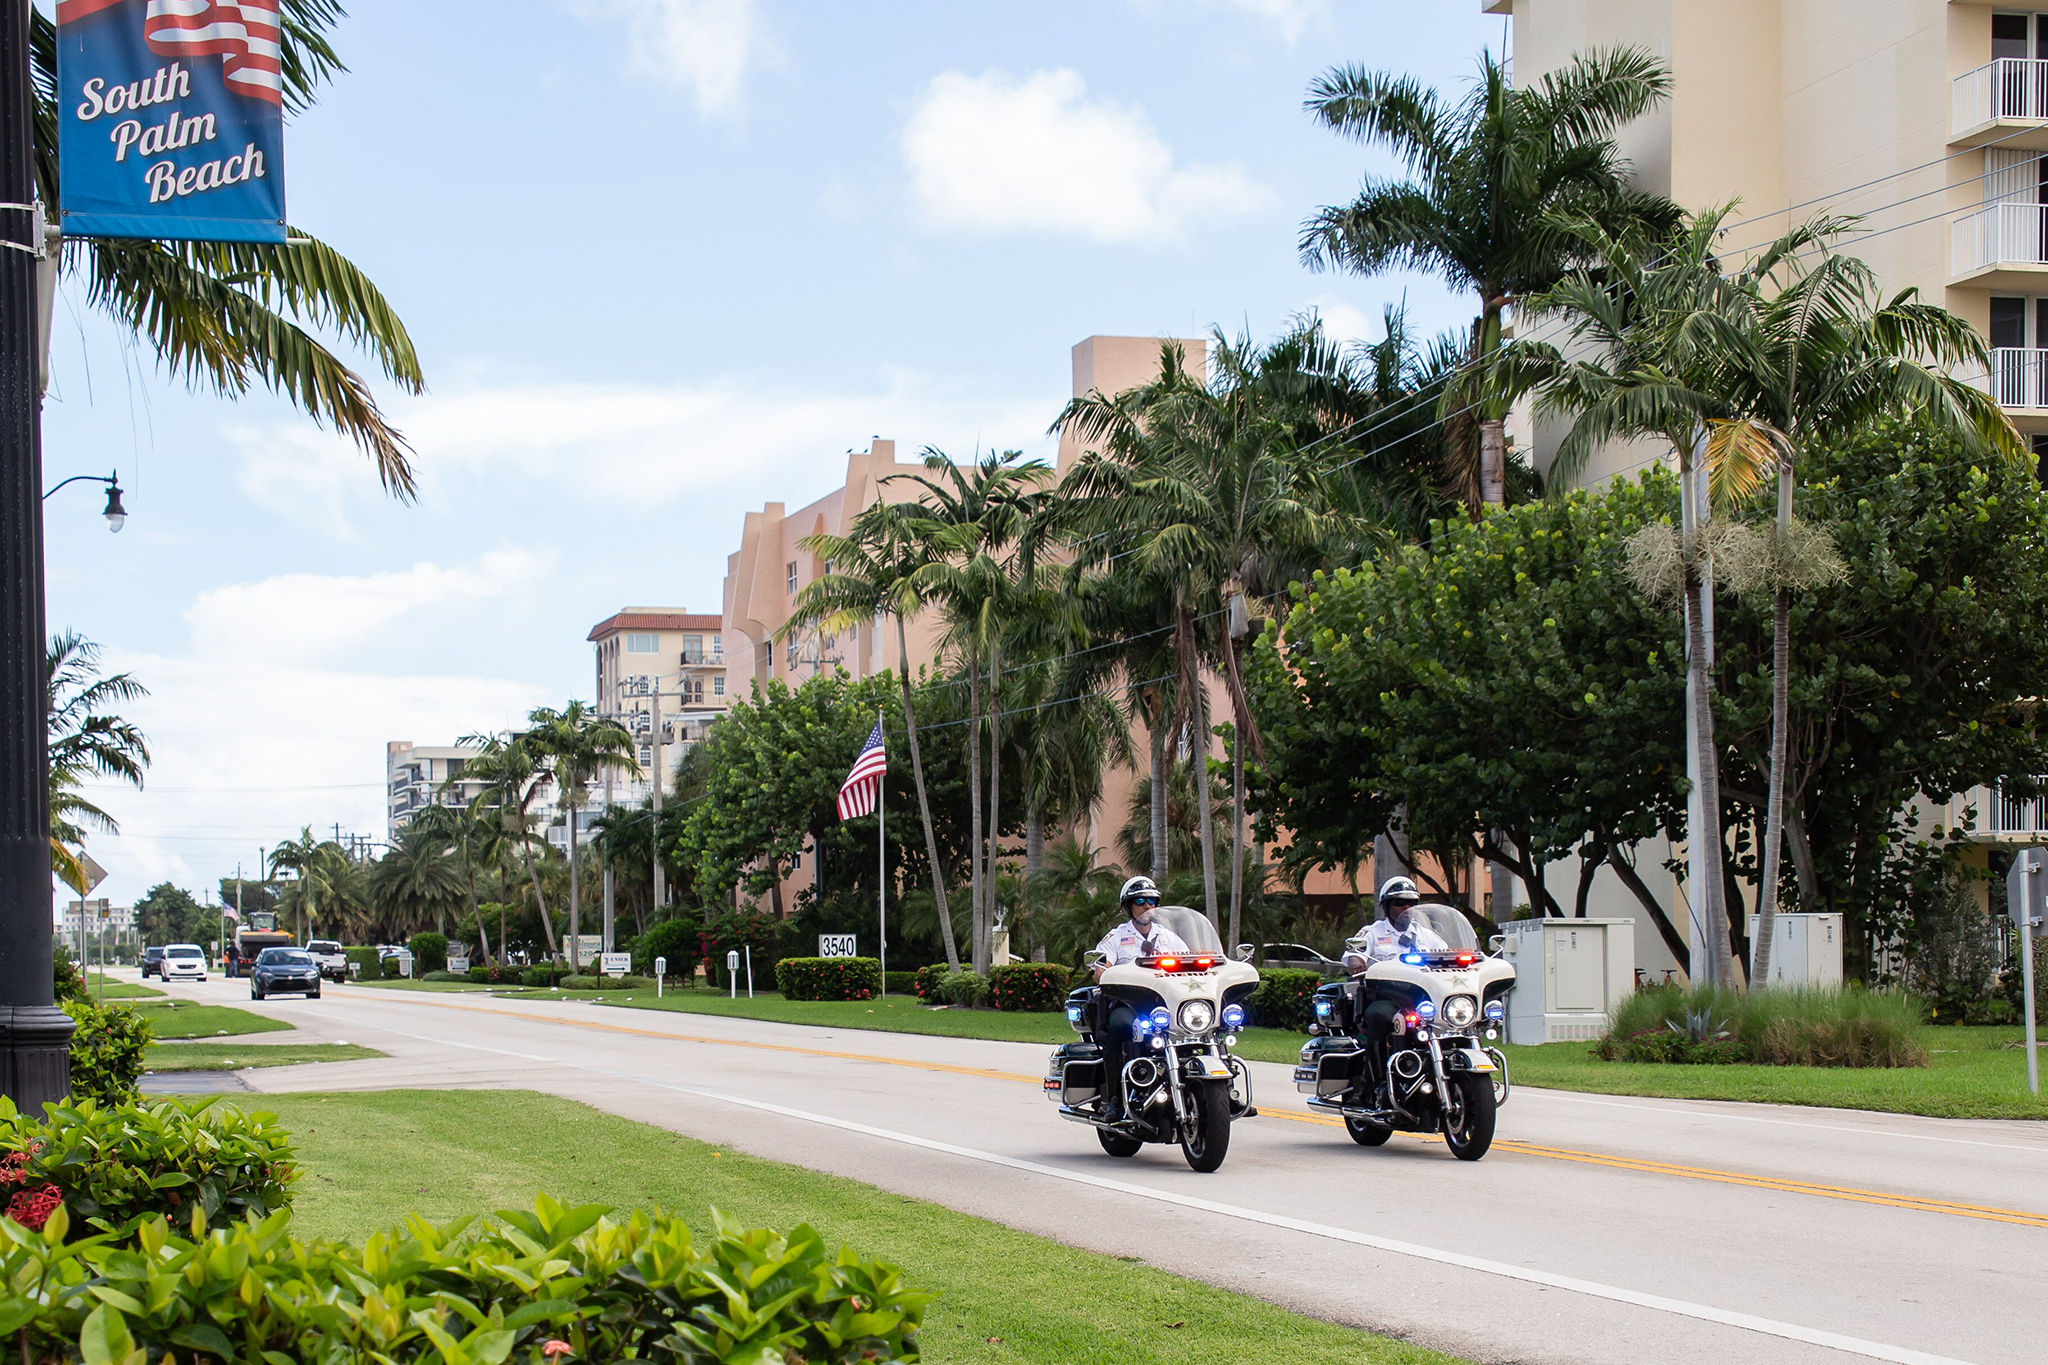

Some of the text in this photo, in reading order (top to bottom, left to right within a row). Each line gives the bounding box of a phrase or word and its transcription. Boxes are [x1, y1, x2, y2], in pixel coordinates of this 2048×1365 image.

[76, 61, 190, 121] South
[110, 111, 216, 162] Palm
[144, 143, 265, 203] Beach
[823, 936, 854, 957] 3540
